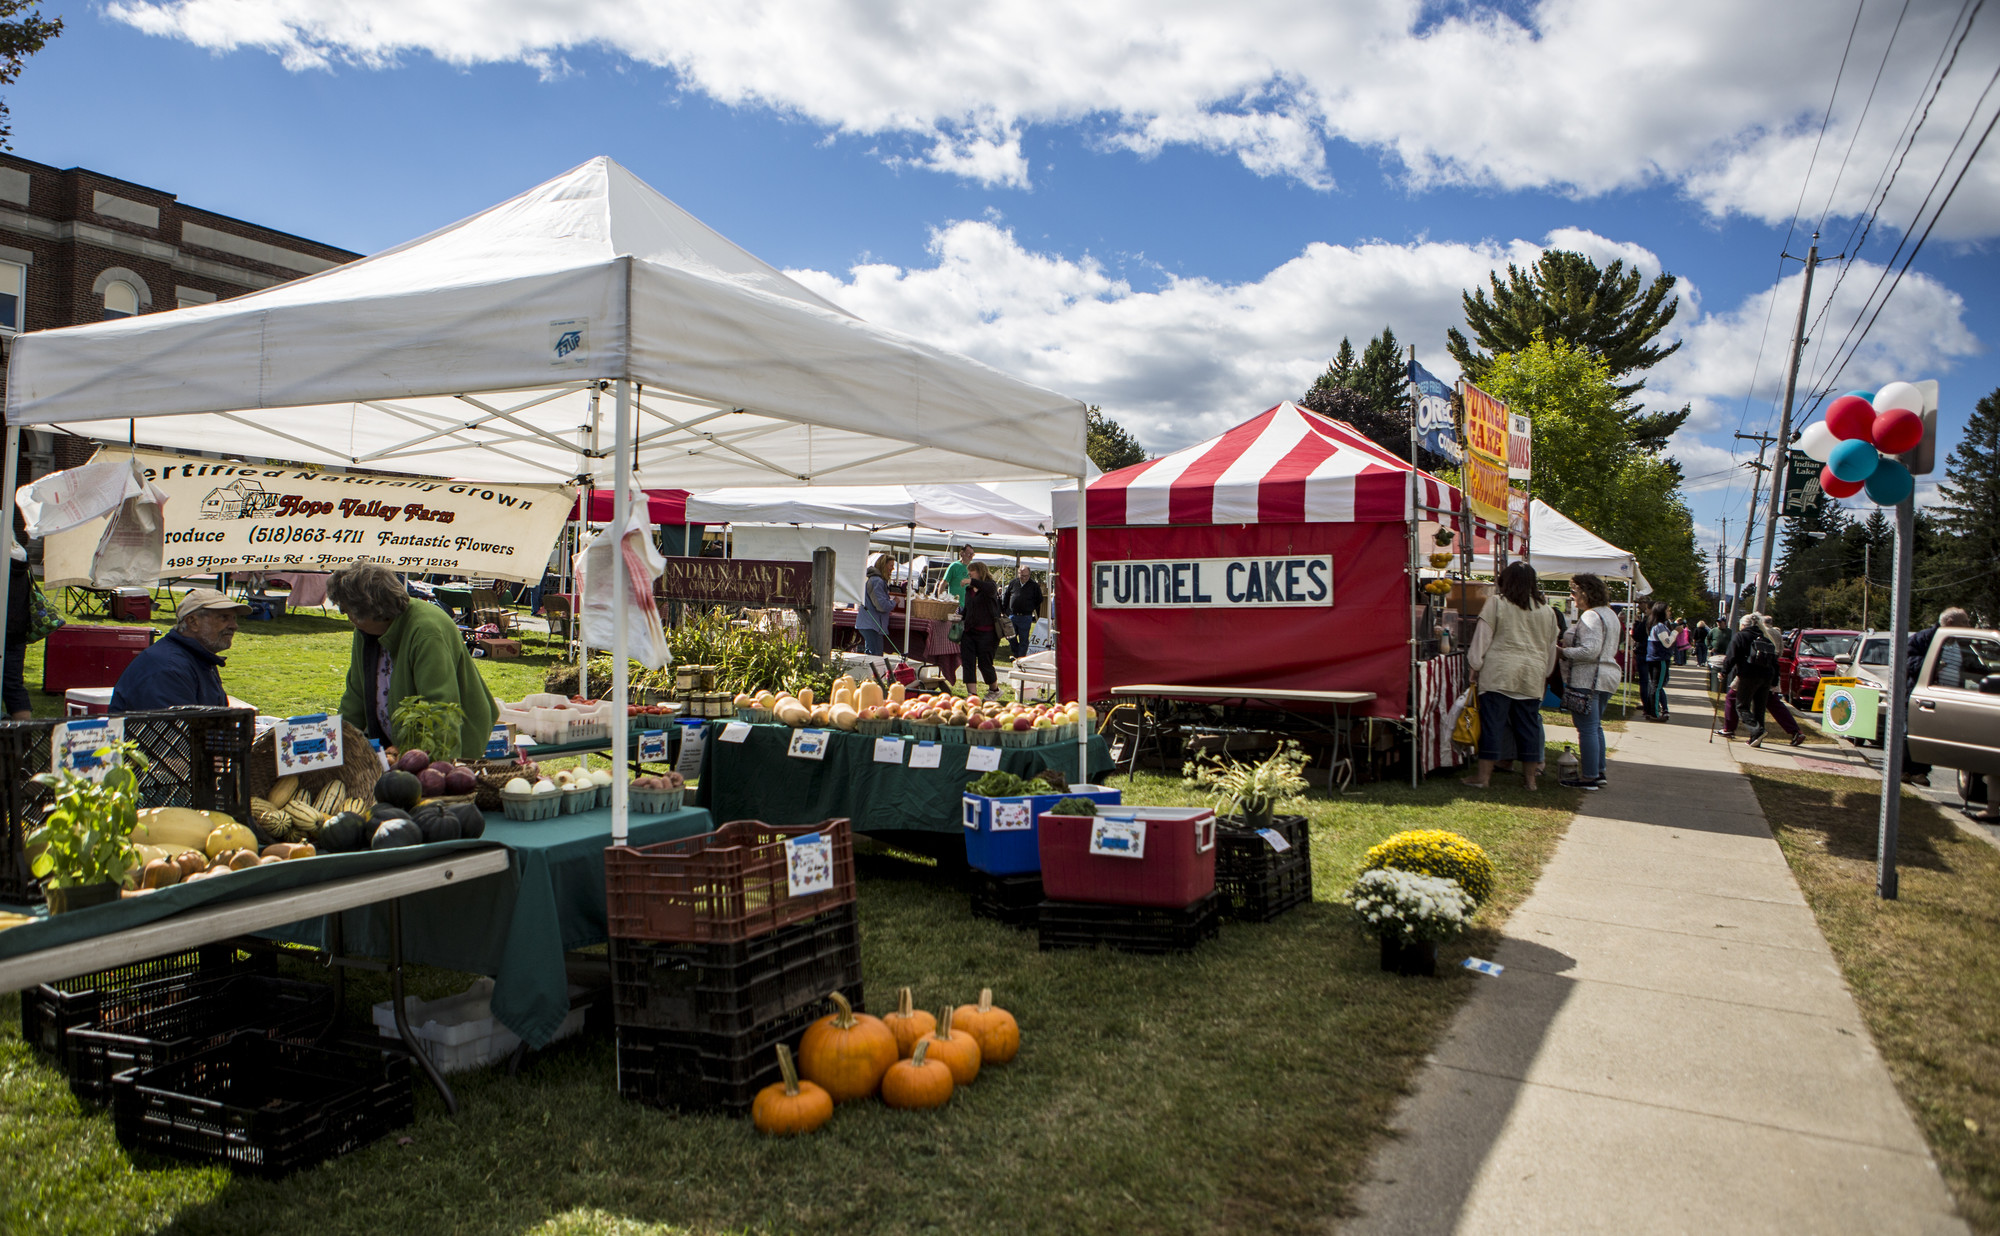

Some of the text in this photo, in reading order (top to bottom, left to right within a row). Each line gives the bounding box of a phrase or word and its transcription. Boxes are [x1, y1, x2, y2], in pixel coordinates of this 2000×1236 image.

[1465, 383, 1508, 432] FUNNEL
[1468, 418, 1502, 457] CAKE
[1793, 460, 1820, 468] Indian
[1795, 467, 1816, 475] Lake
[143, 464, 534, 511] ertified Naturally Grown
[274, 494, 456, 524] Hope Valley Farm
[165, 528, 225, 544] roduce
[249, 525, 365, 545] (518)863-4711
[377, 531, 451, 548] Fantastic
[454, 536, 515, 556] Flowers
[166, 556, 194, 568] 498
[197, 555, 238, 567] Hope
[242, 554, 280, 565] Falls
[284, 554, 304, 565] Rd
[316, 553, 354, 564] Hope
[398, 556, 424, 566] NY
[425, 557, 459, 568] 12134
[737, 561, 796, 599] LAKE
[1096, 559, 1328, 604] FUNNEL CAKES
